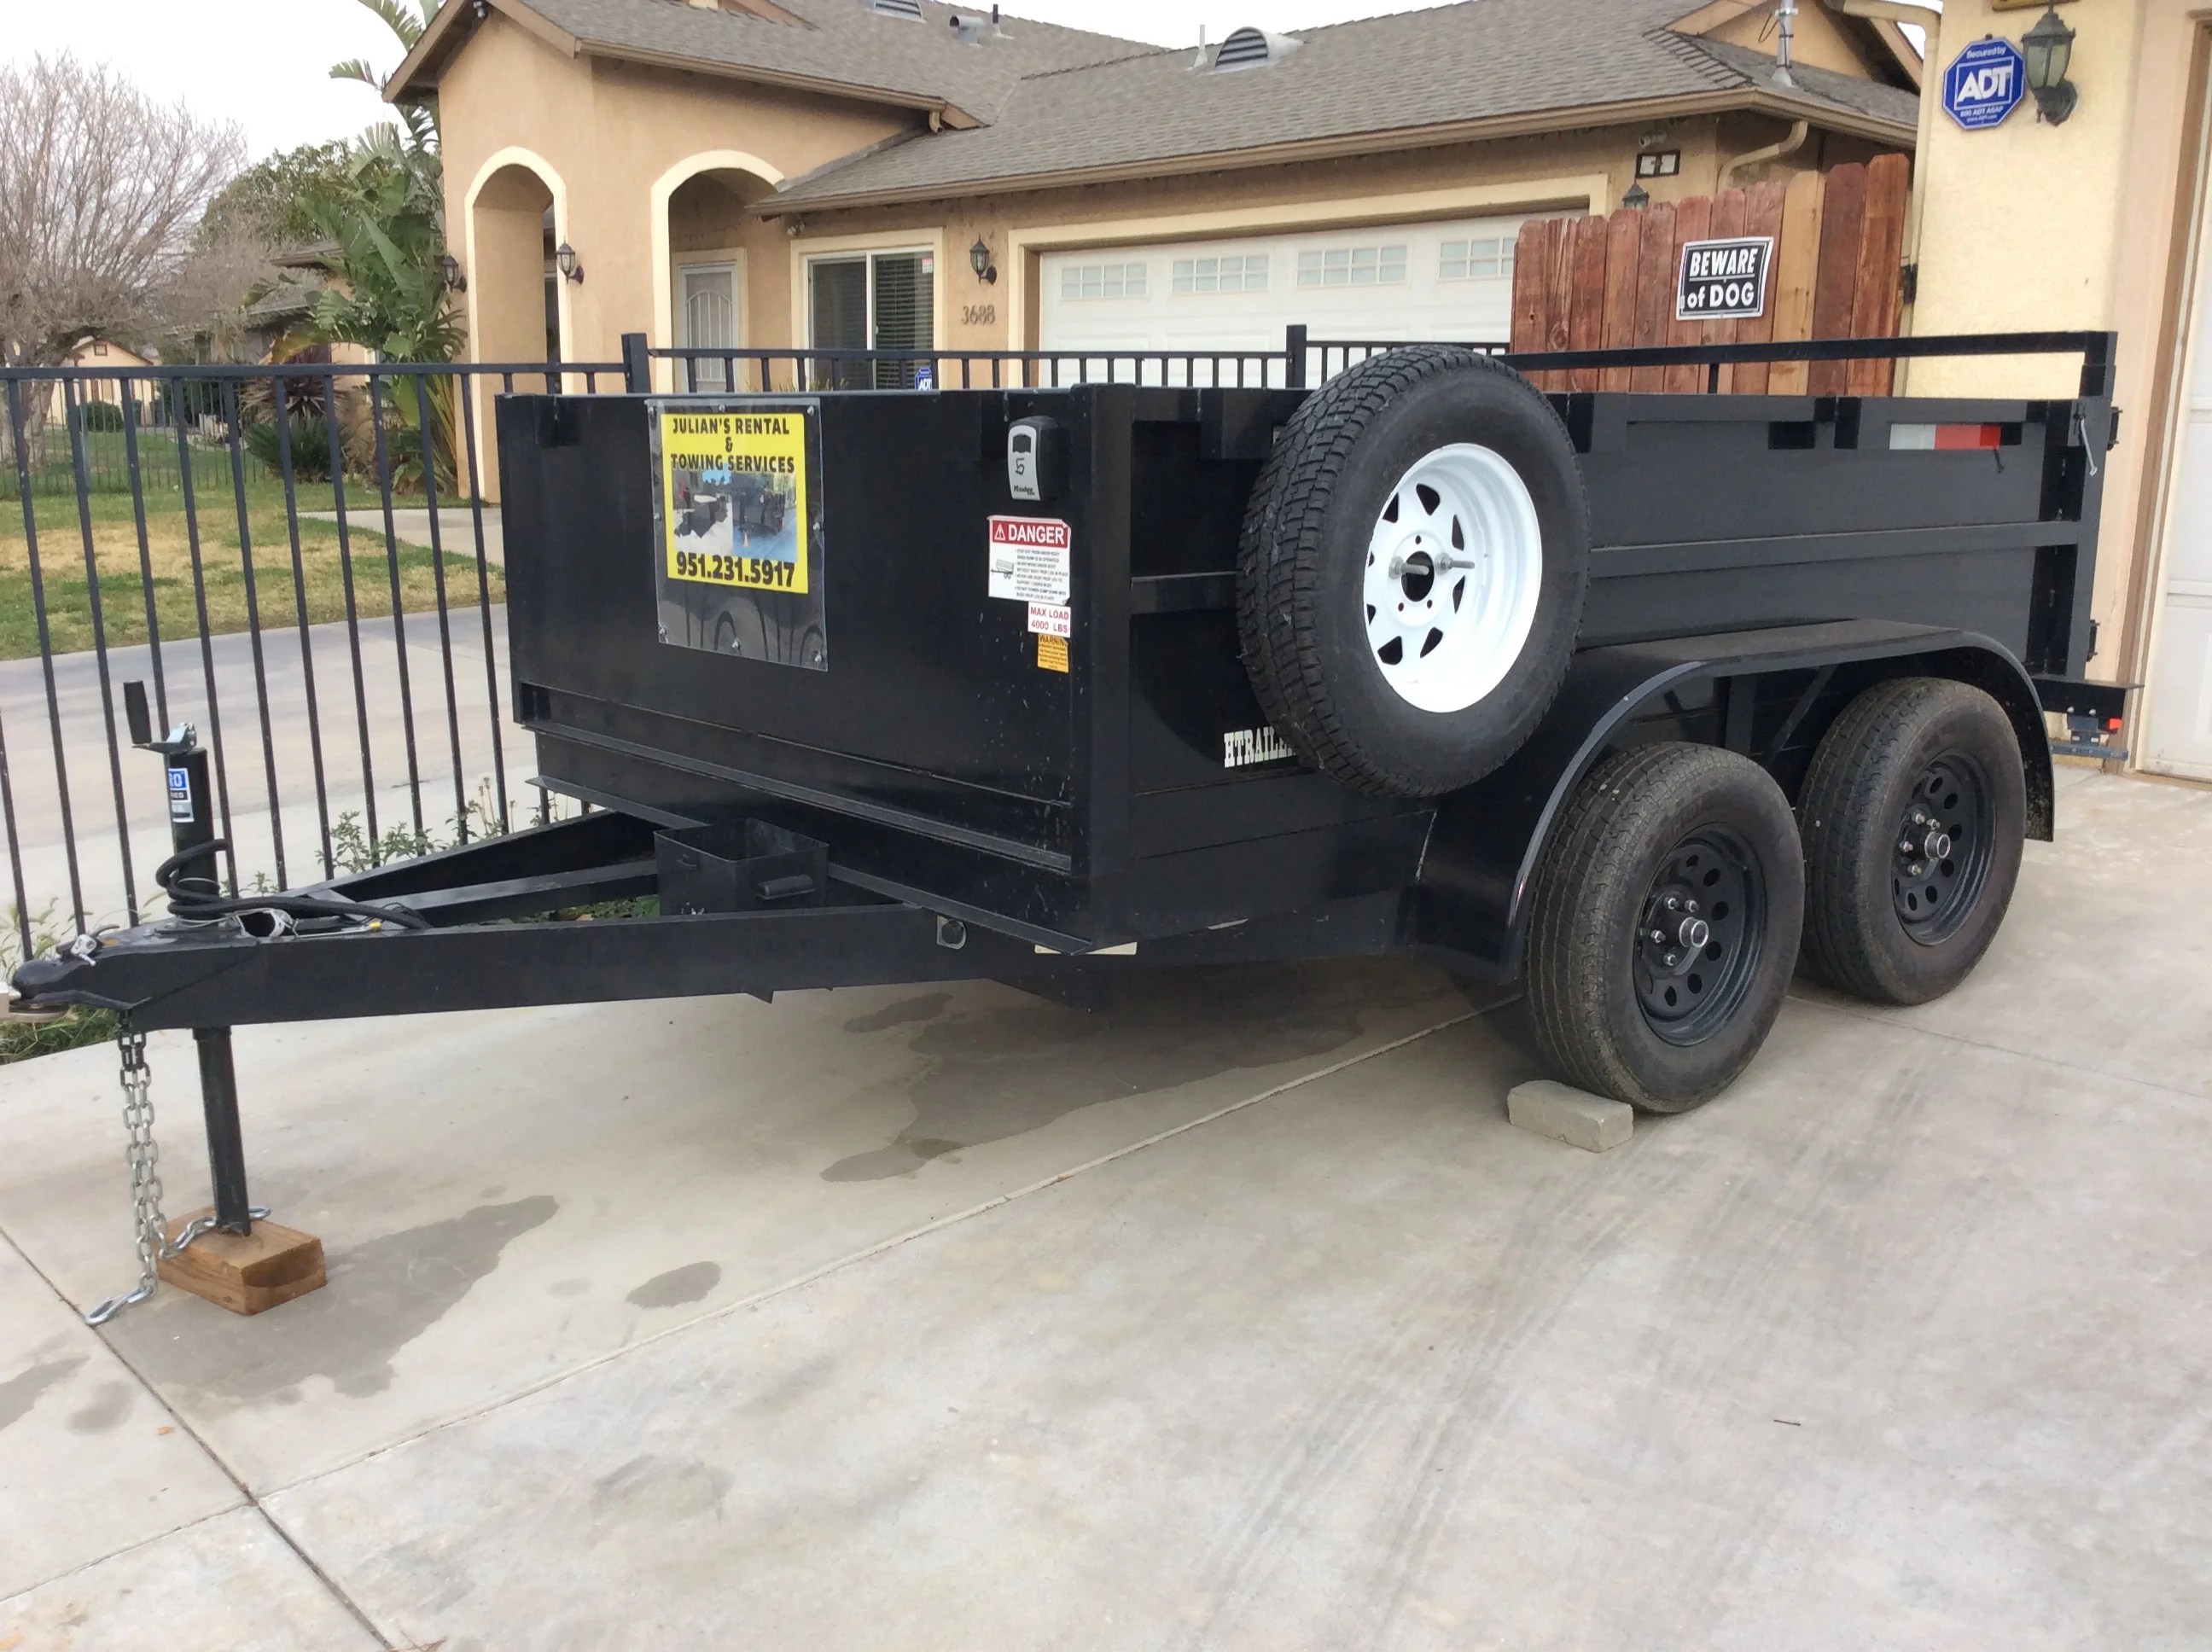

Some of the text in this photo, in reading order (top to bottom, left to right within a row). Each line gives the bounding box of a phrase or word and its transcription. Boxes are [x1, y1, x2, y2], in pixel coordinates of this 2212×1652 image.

[1966, 46, 2006, 59] Secured by
[1957, 65, 2013, 102] ADT
[1689, 248, 1758, 276] BEWARE
[1687, 282, 1755, 308] of DOG
[961, 304, 996, 325] 3688
[918, 378, 932, 391] ADT
[672, 417, 790, 434] JULIAN'S RENTAL
[725, 436, 733, 452] &
[670, 454, 795, 474] TOWING SERVICES
[1008, 523, 1065, 544] DANGER
[677, 551, 795, 587] 951.231.5917
[1030, 607, 1069, 620] MAX LOAD
[1031, 620, 1068, 633] 4000 LBS
